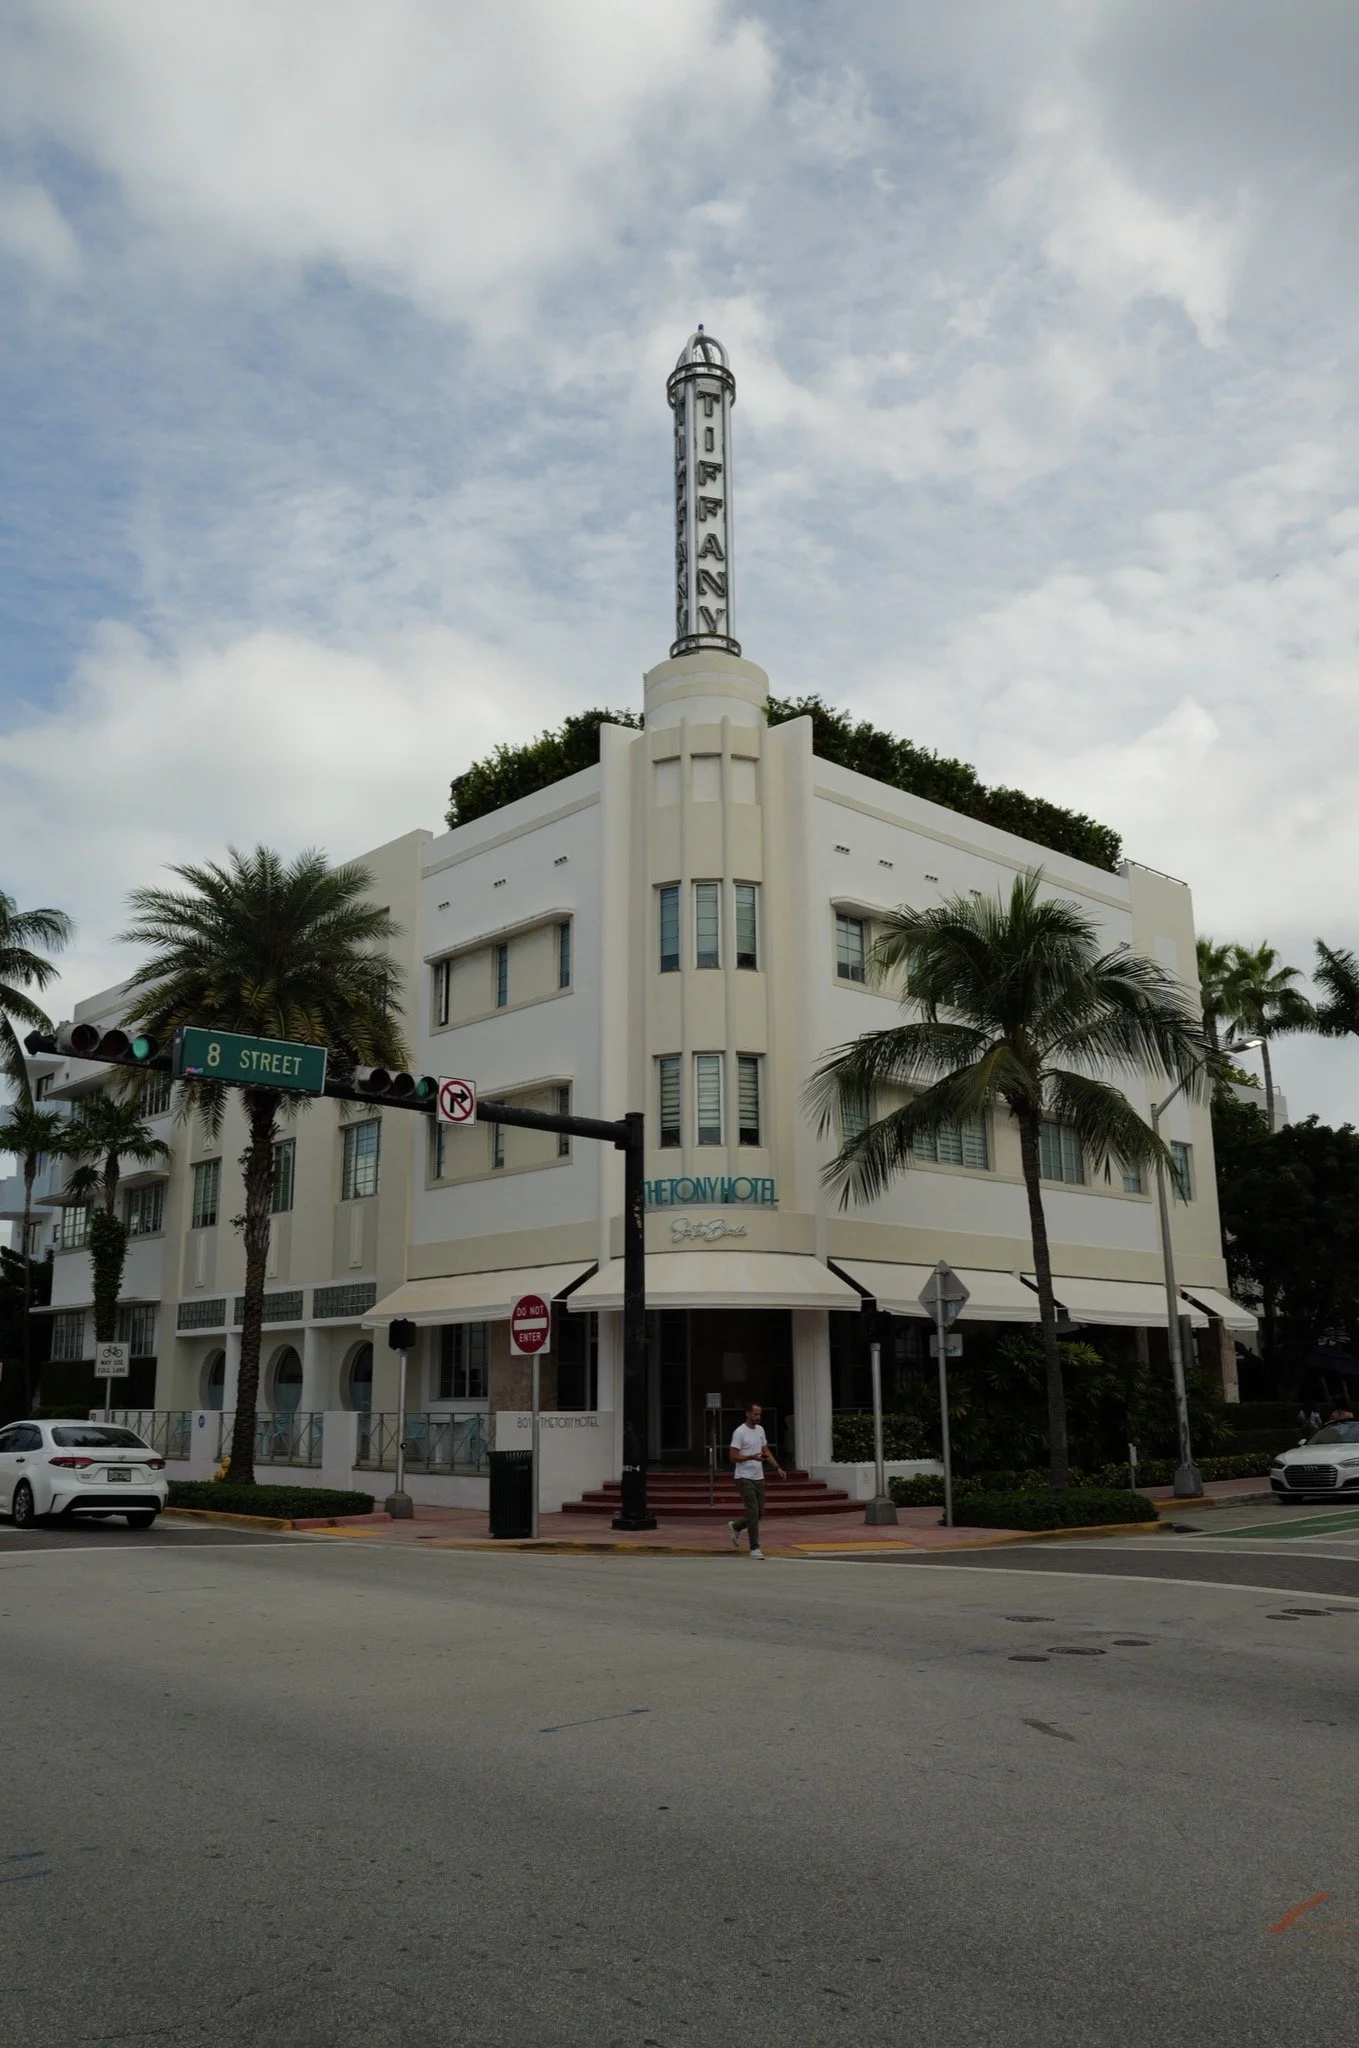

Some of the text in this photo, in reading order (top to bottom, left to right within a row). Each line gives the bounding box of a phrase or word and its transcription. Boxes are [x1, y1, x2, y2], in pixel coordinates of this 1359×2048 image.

[697, 390, 728, 635] TIFFANY
[207, 1043, 302, 1075] 8 STREET
[667, 1177, 719, 1206] TONY
[721, 1176, 780, 1205] HOTEL
[516, 1304, 545, 1317] DO NOT
[519, 1332, 542, 1343] ENTER
[575, 1415, 599, 1428] HOTEL
